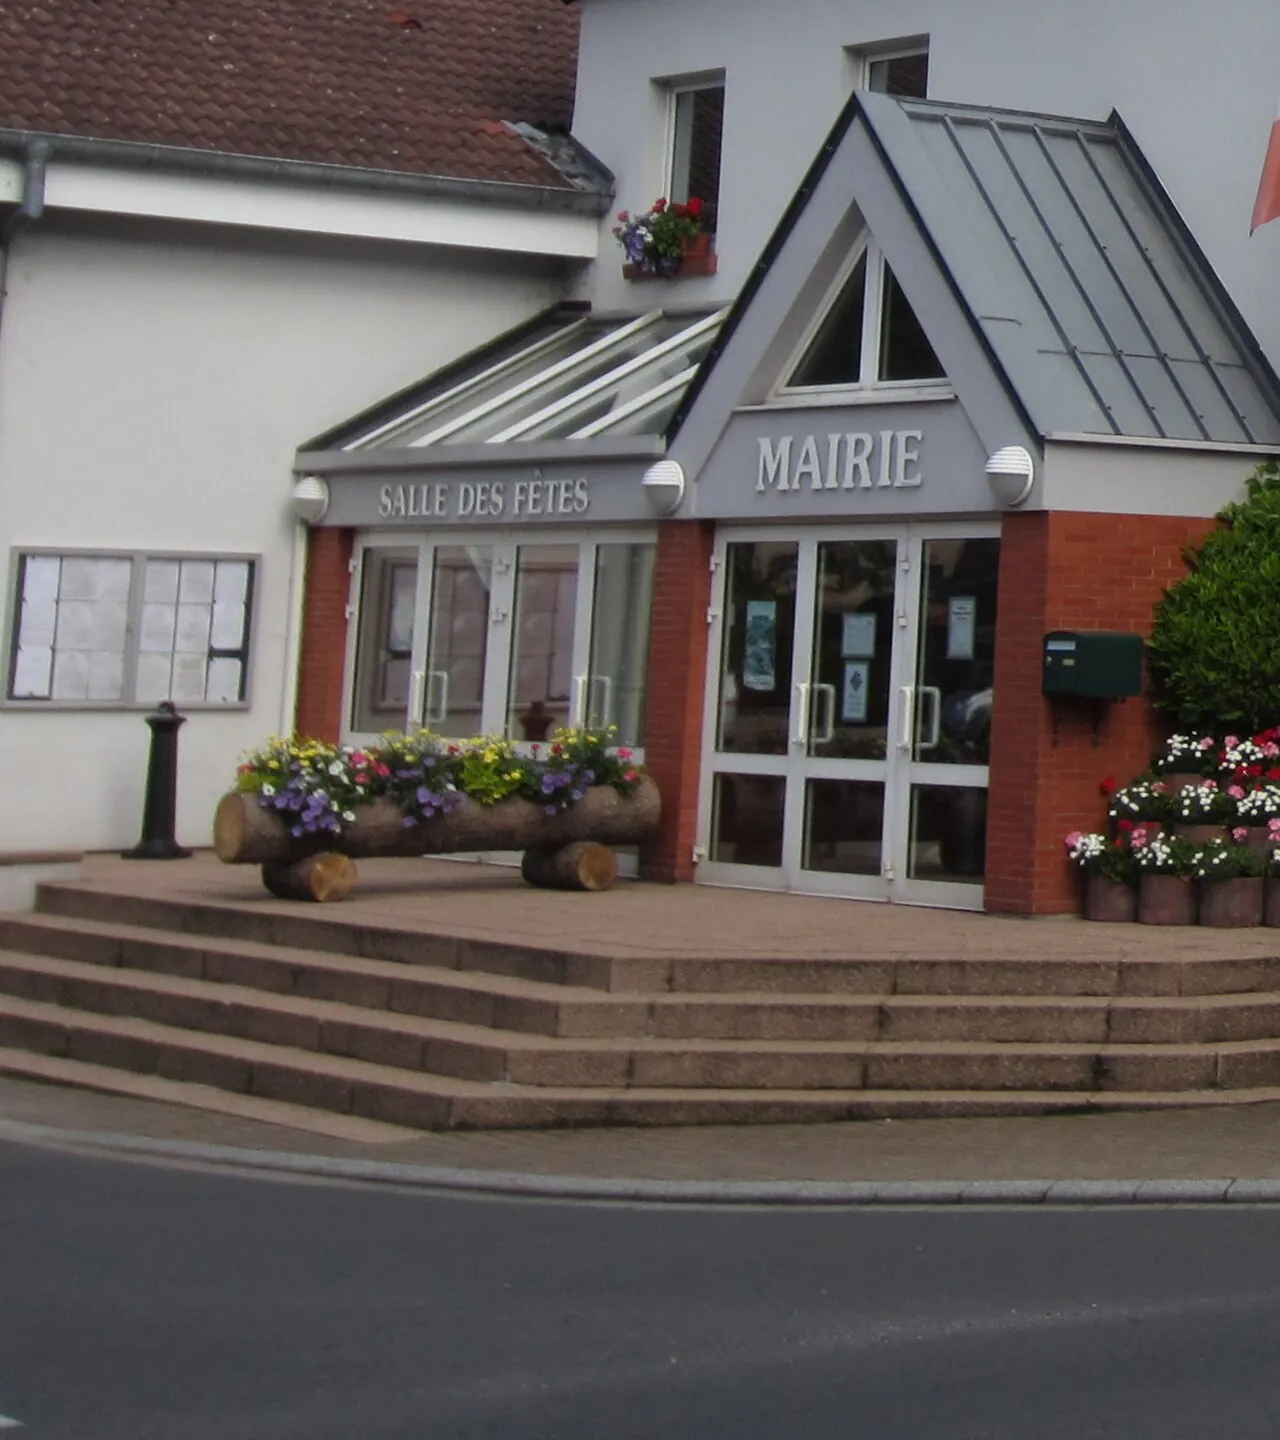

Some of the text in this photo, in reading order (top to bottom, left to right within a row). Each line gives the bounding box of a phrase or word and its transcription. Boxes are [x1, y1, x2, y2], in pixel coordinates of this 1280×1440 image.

[755, 430, 923, 491] MAIRIE
[379, 468, 589, 517] SALLE DES FÊTES
